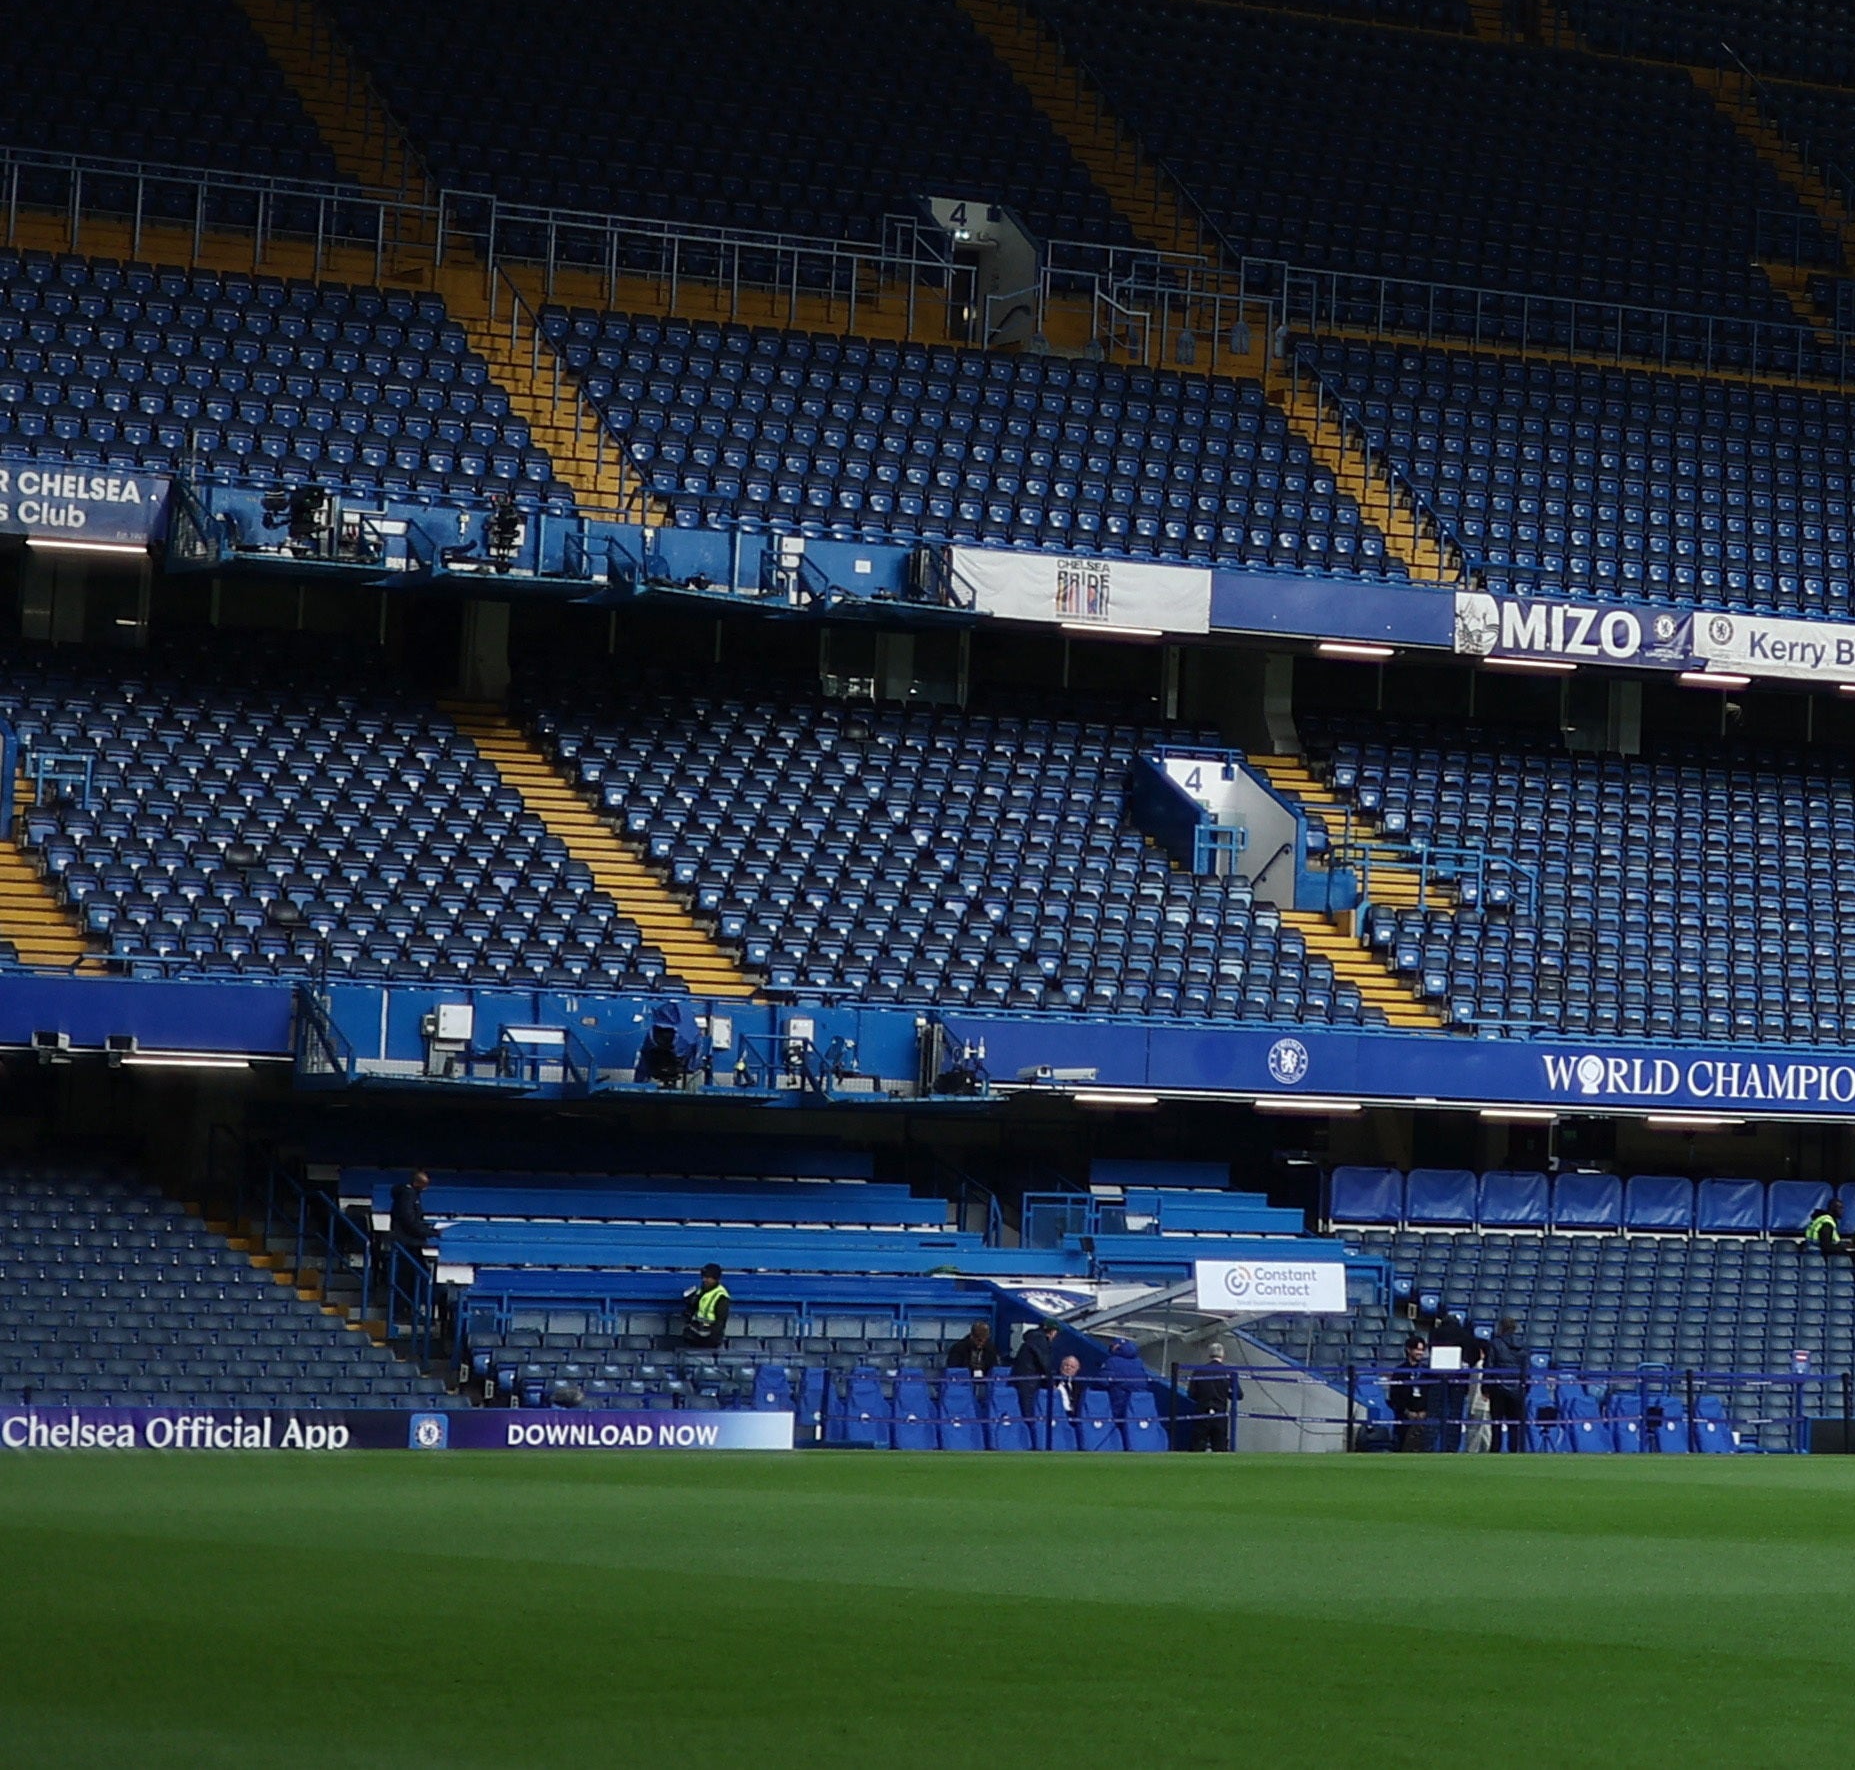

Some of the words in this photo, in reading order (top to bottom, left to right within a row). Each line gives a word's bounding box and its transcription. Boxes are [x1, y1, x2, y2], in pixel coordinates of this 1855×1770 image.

[949, 203, 966, 226] 4
[17, 471, 141, 504] CHELSEA
[18, 500, 86, 528] Club
[1057, 559, 1111, 573] CHELSEA
[1502, 601, 1641, 658] MIZO
[1749, 630, 1826, 668] Kerry
[1185, 767, 1202, 792] 4
[1542, 1054, 1680, 1097] WORLD
[1254, 1267, 1318, 1281] Constant
[1254, 1282, 1310, 1296] Contact
[2, 1415, 135, 1448] Chelsea
[146, 1416, 271, 1449] Official
[280, 1417, 349, 1449] App
[507, 1424, 653, 1447] DOWNLOAD
[659, 1424, 719, 1446] NOW
